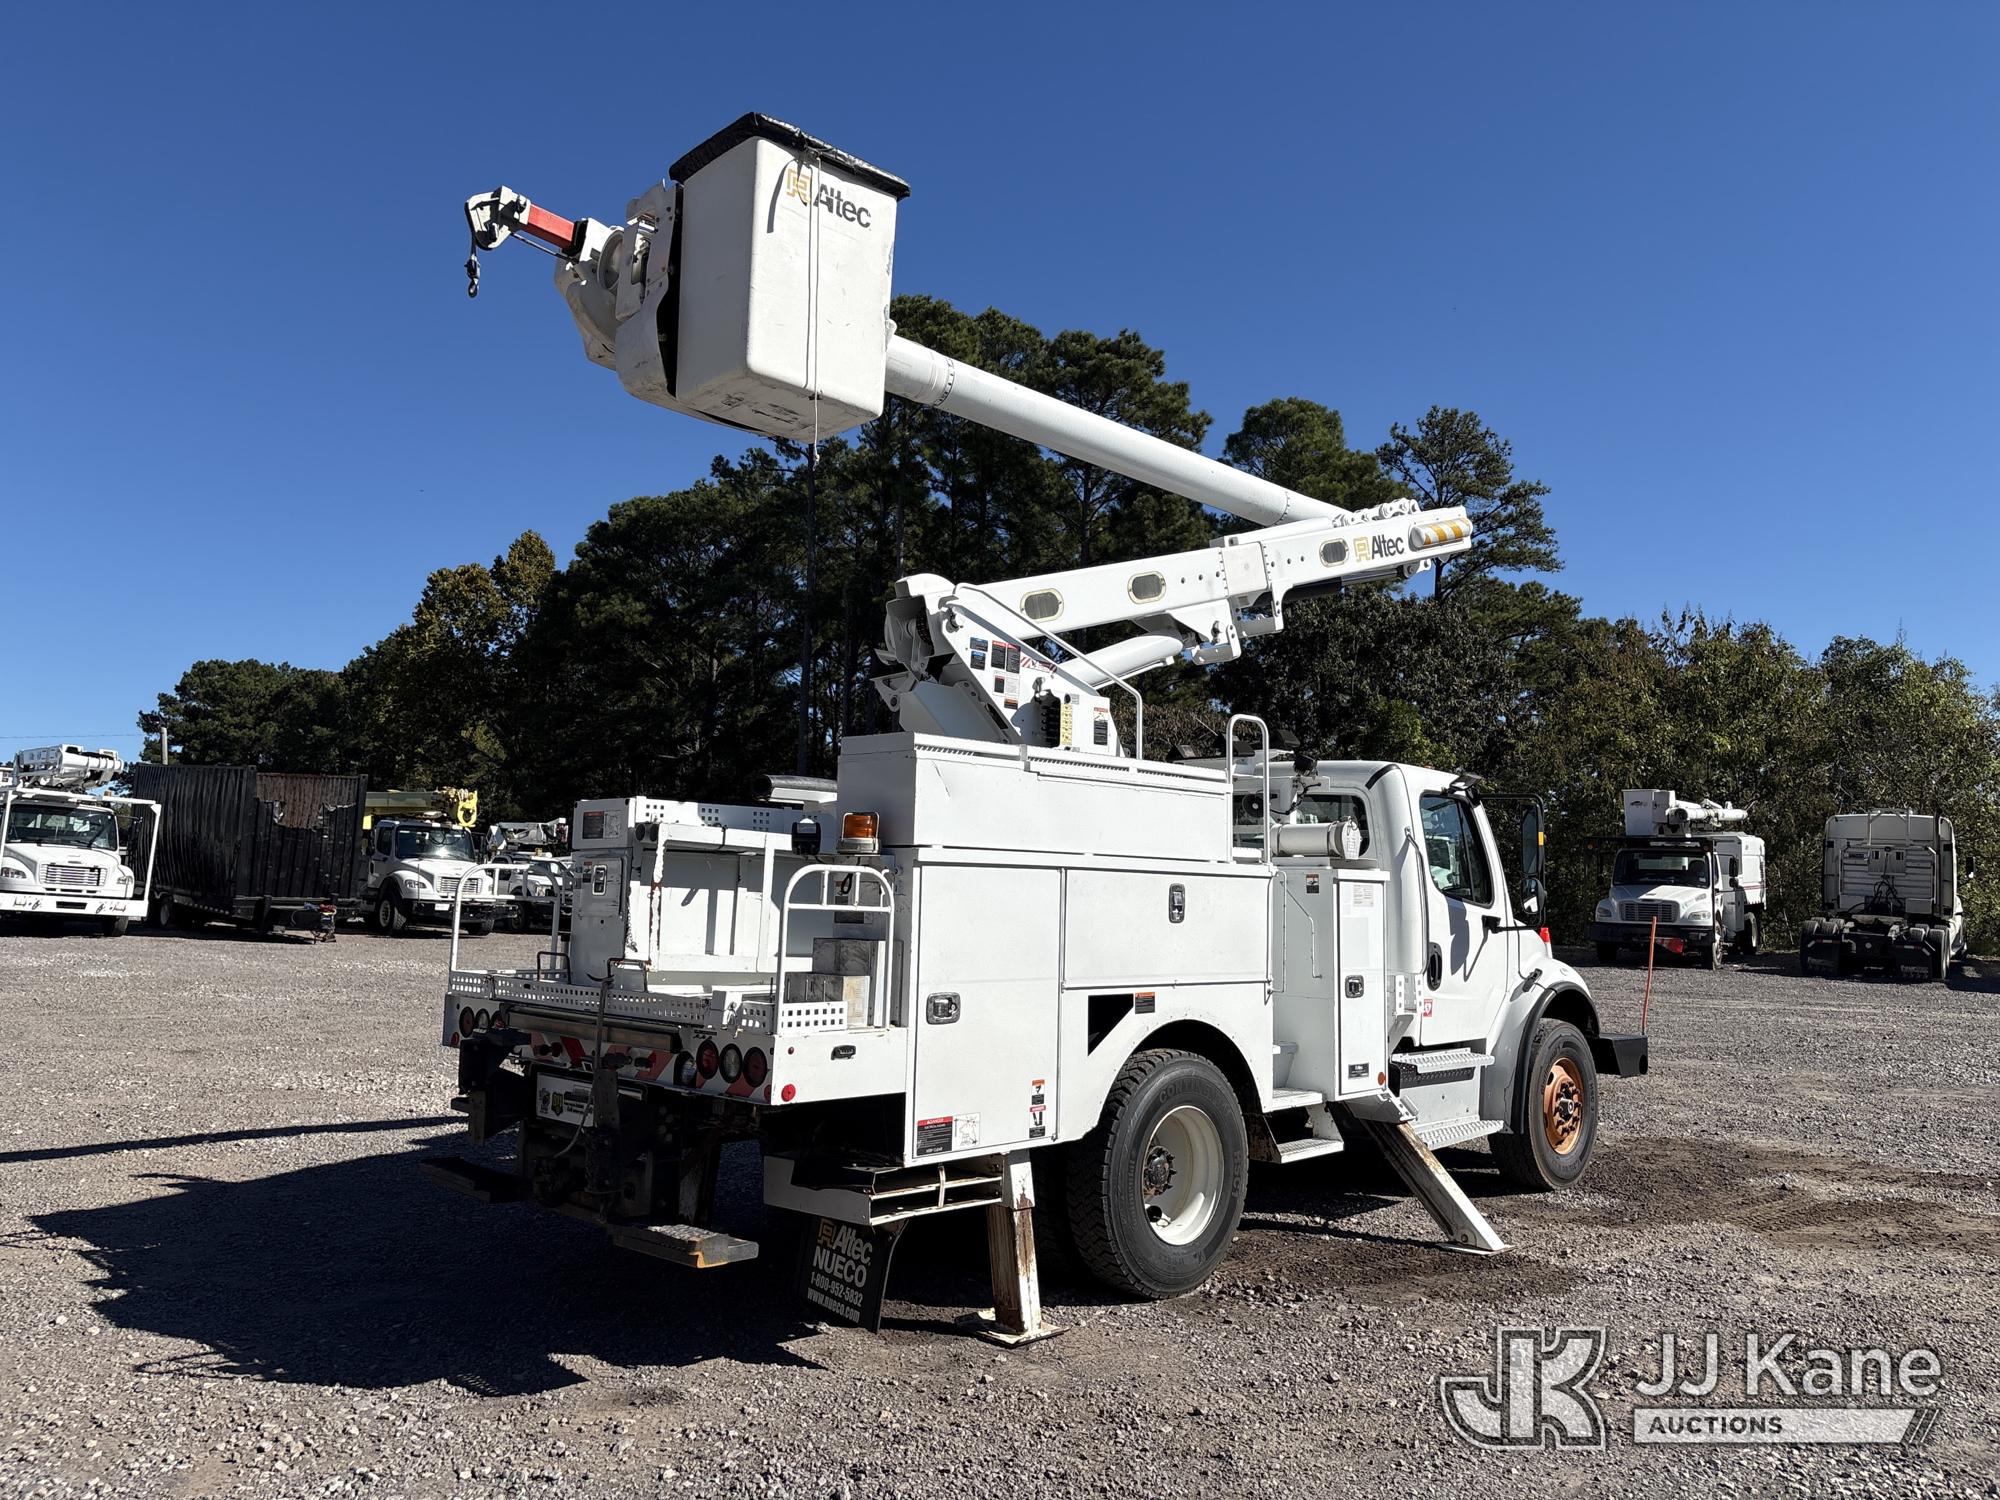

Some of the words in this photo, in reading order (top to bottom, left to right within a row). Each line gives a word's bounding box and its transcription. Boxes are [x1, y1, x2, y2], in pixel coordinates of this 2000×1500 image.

[812, 183, 871, 229] Altec
[1371, 534, 1405, 560] Altec
[832, 1224, 873, 1264] Altec
[812, 1245, 867, 1288] NUECO
[807, 1287, 861, 1324] www.nueco.com
[811, 1271, 863, 1308] 1-800-952-5832
